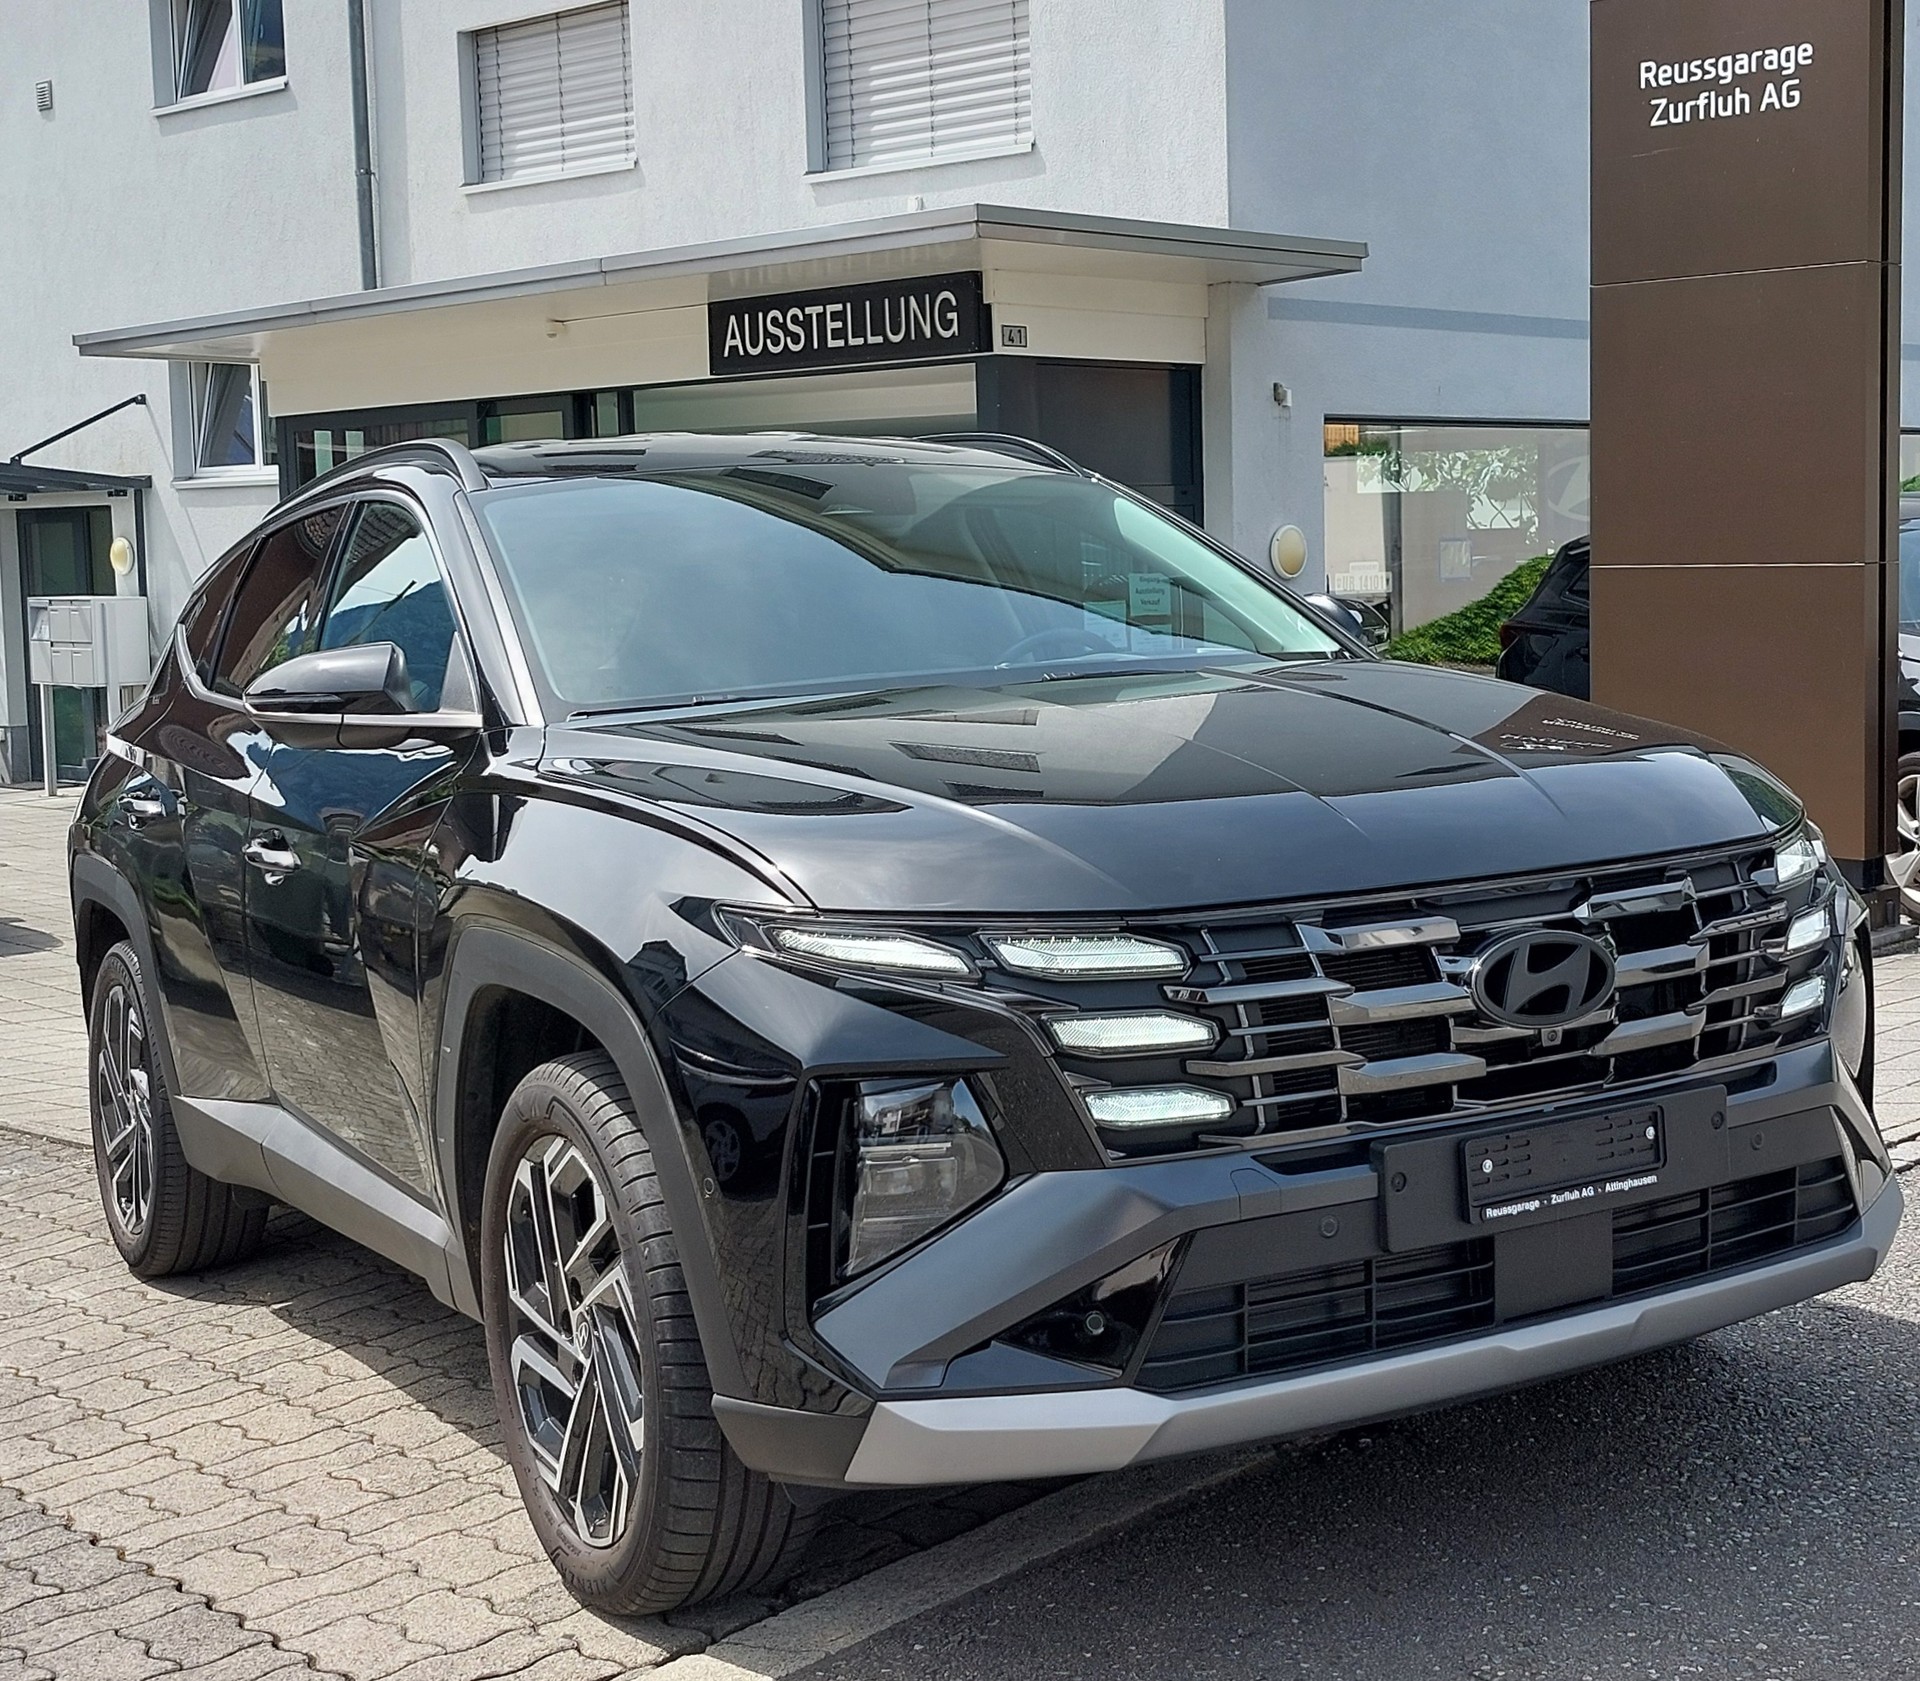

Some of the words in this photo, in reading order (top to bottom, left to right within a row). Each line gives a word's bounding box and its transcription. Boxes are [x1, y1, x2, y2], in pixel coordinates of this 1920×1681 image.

[1639, 42, 1814, 89] Reussgarage
[1649, 87, 1750, 127] Zurfluh
[1759, 78, 1801, 112] AG
[723, 290, 959, 358] AUSSTELLUNG
[1008, 329, 1022, 345] 41
[1485, 1199, 1540, 1219] Reussgarage
[1550, 1191, 1581, 1205] Zurfluh
[1581, 1186, 1595, 1197] AG
[1604, 1174, 1658, 1193] Attinghausen
